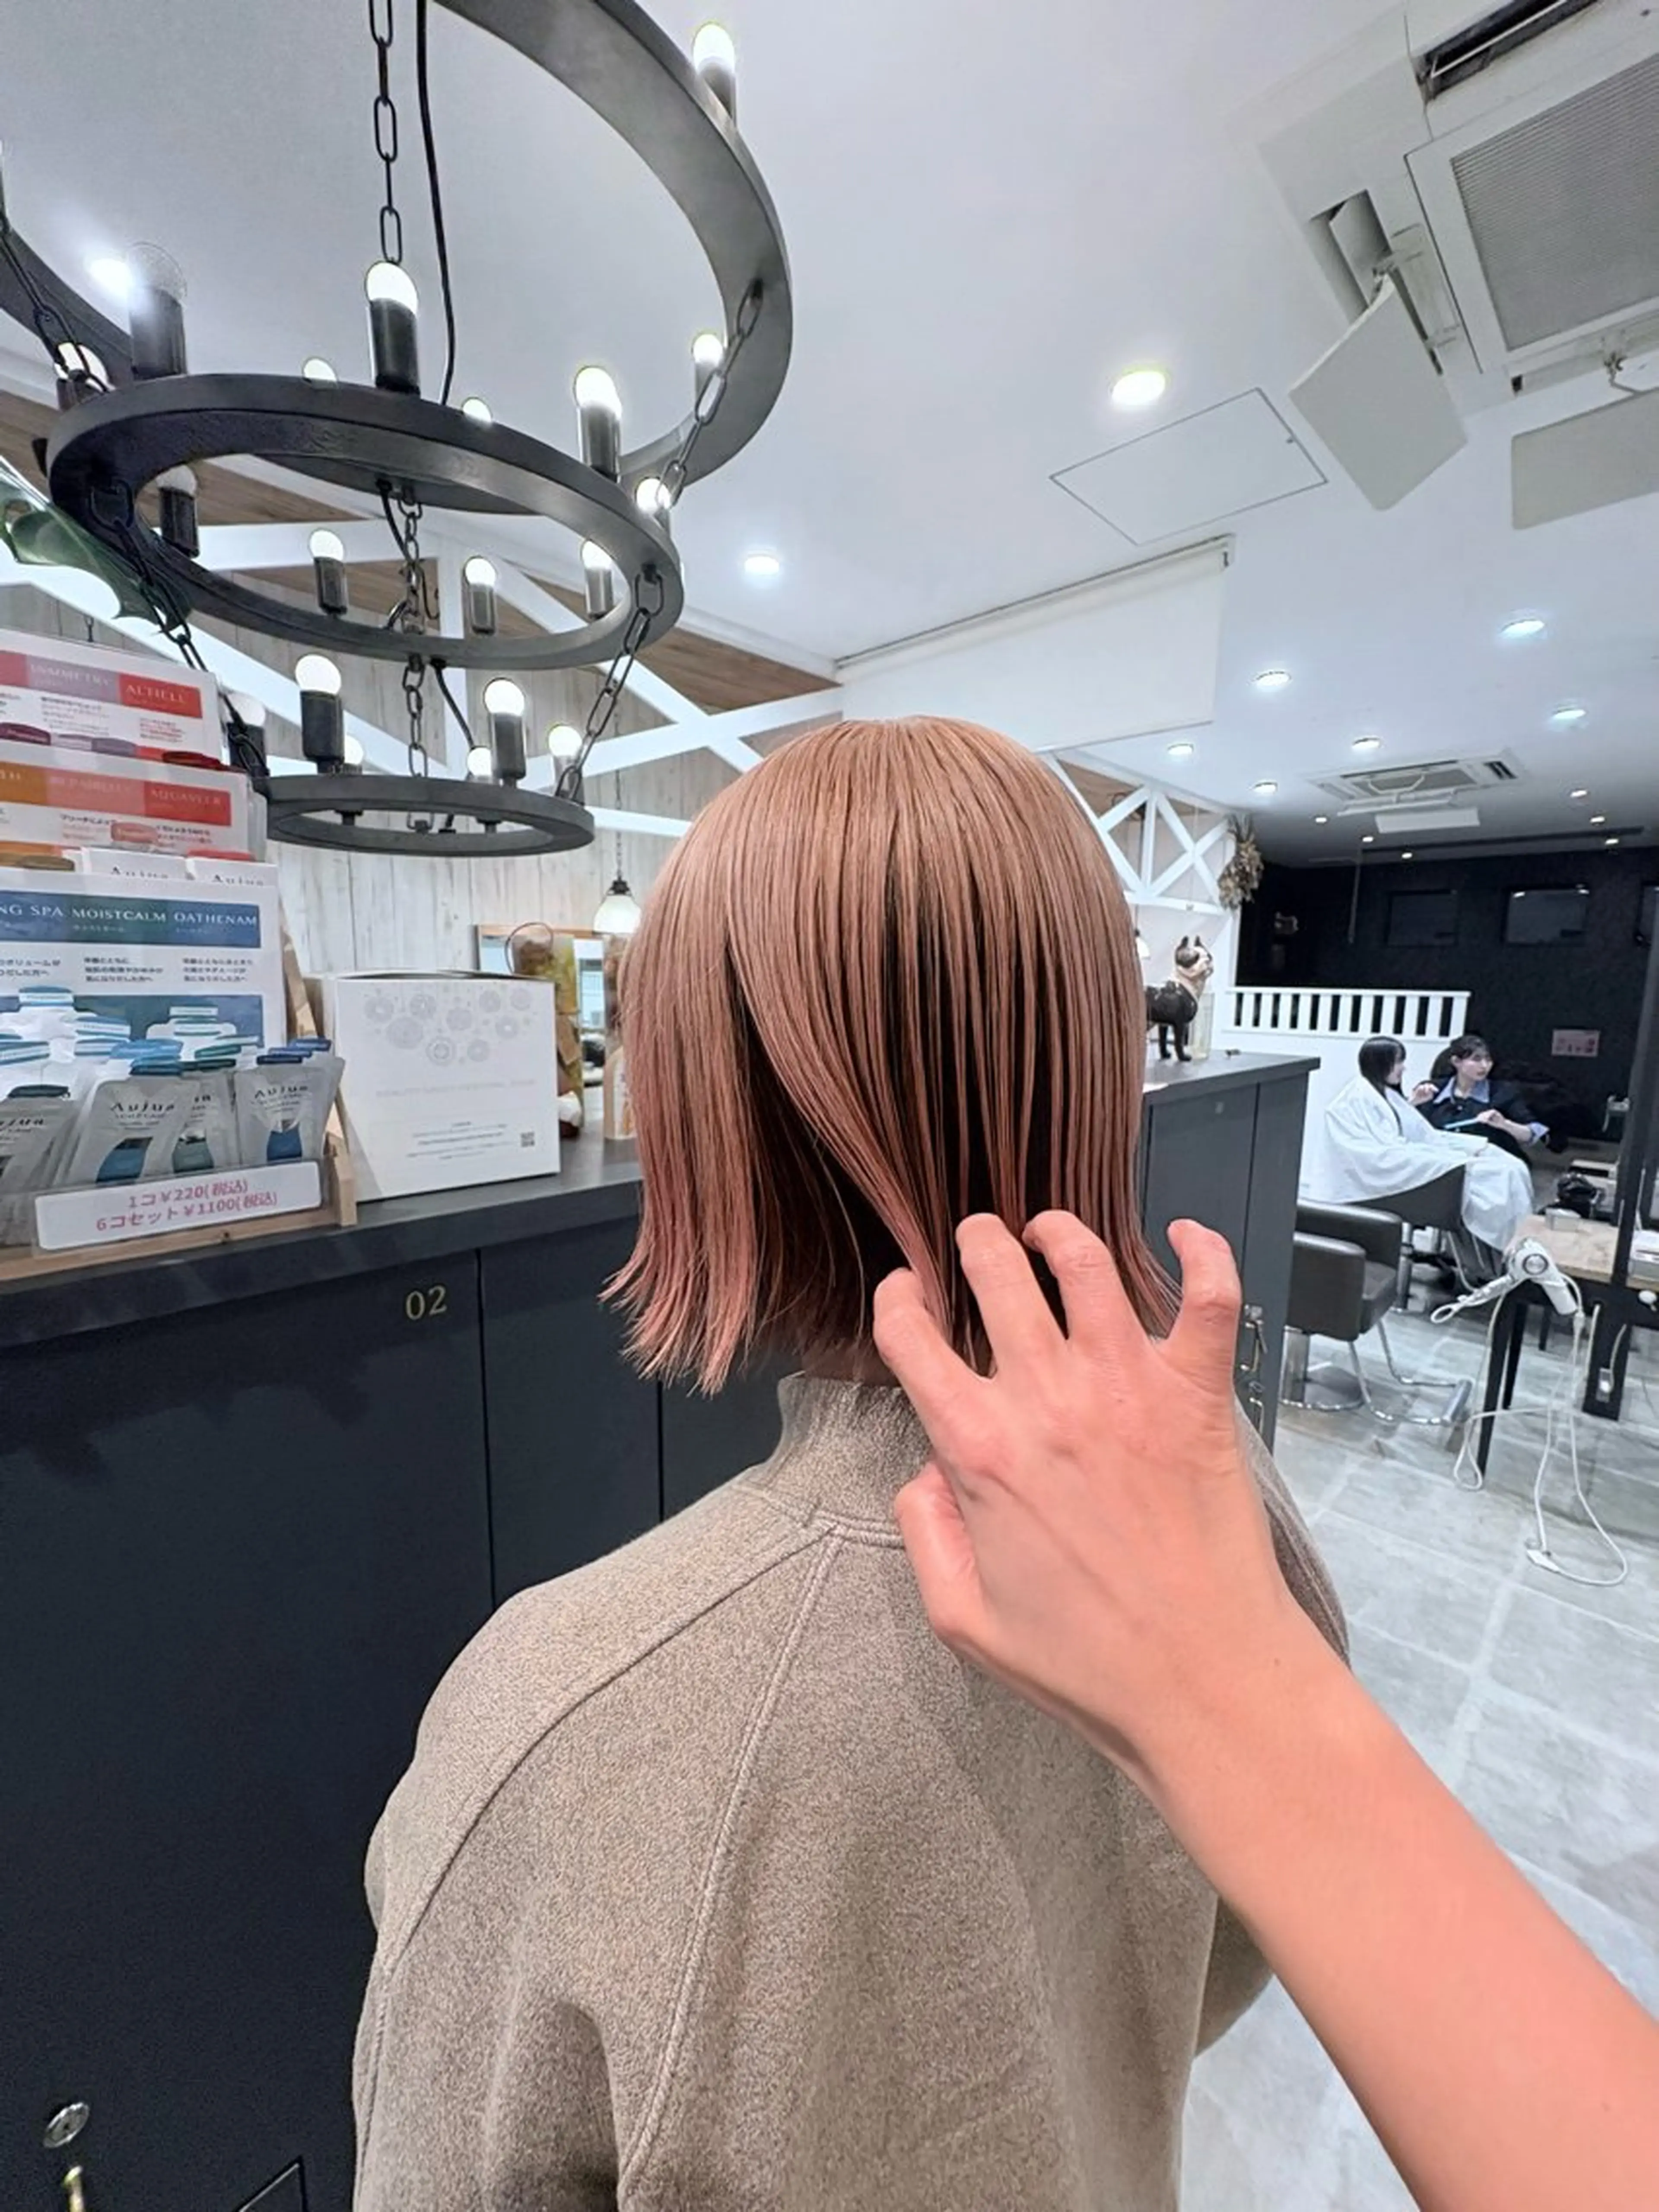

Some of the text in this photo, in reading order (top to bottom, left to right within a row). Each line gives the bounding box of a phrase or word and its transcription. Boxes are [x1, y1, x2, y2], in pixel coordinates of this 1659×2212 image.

[30, 905, 64, 918] SPA
[72, 908, 166, 922] MOISTCALM
[405, 1284, 448, 1320] 02
